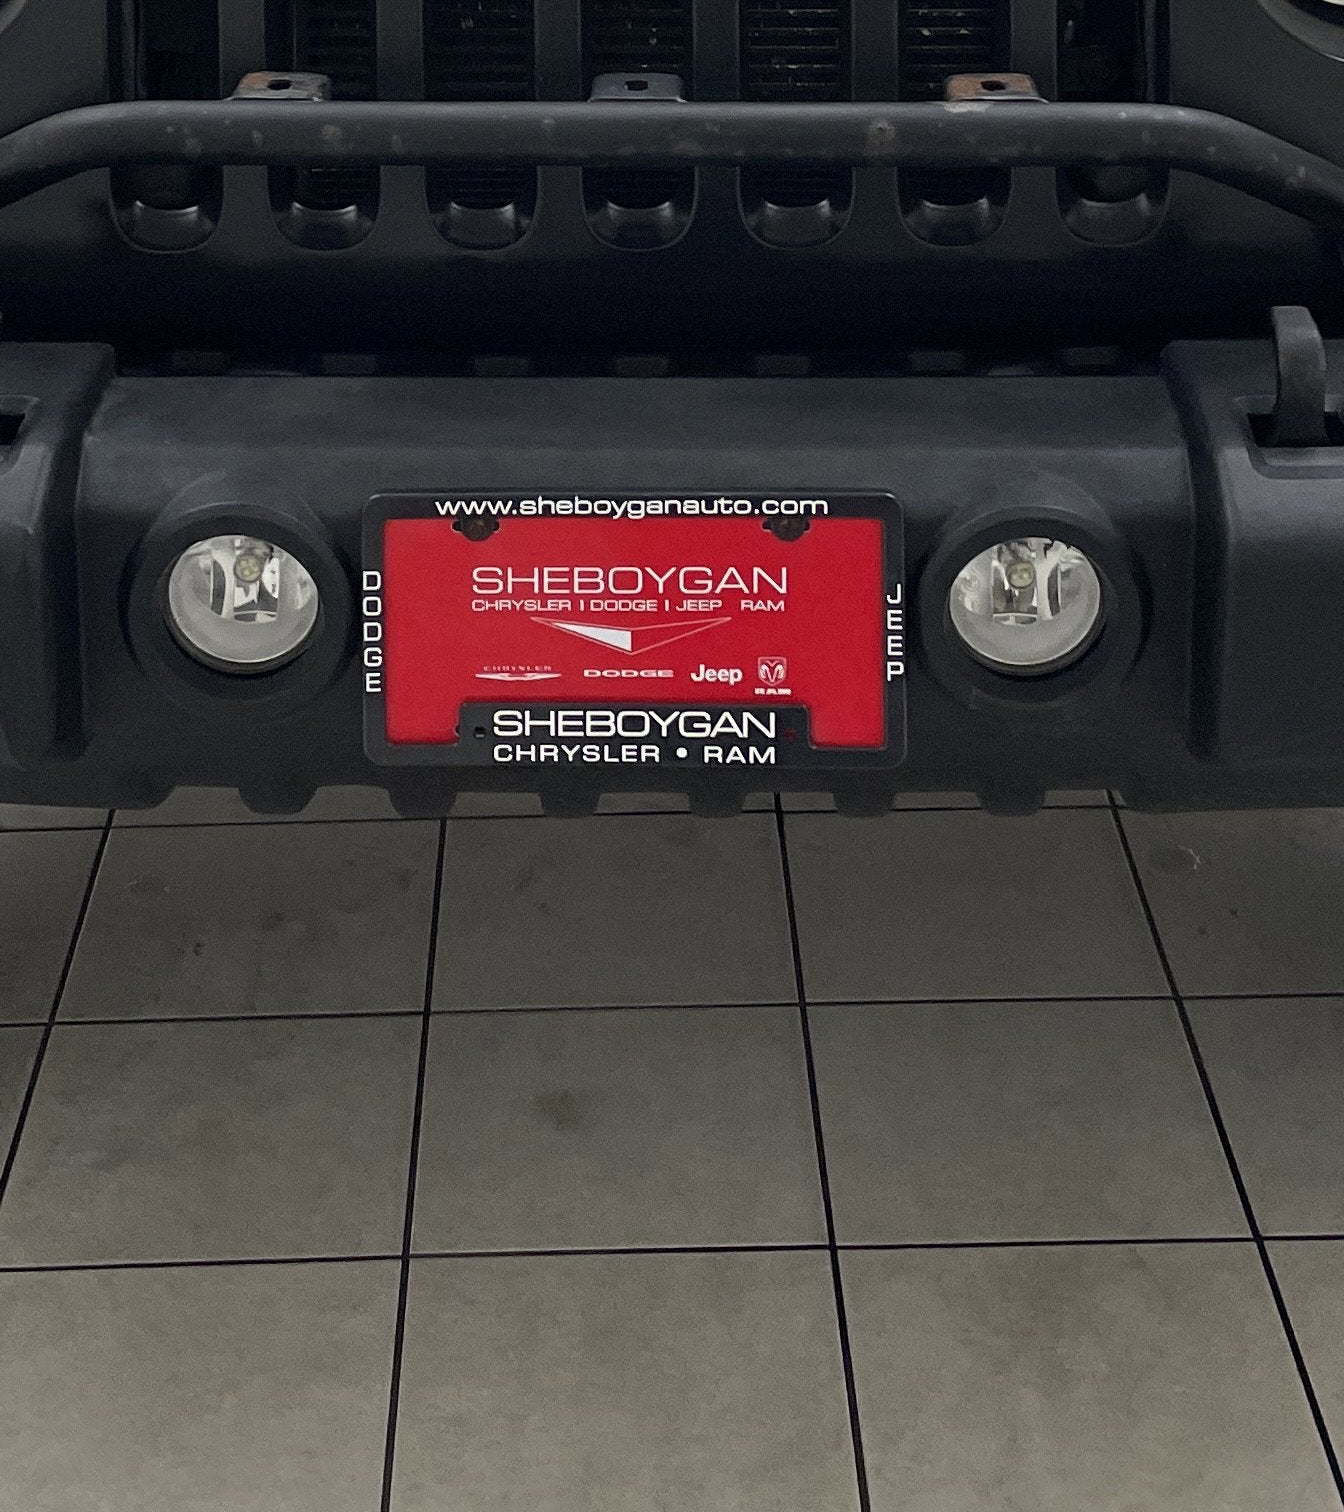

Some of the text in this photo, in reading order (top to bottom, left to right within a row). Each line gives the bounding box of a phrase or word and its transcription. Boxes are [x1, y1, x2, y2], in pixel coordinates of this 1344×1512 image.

[435, 495, 828, 519] www.sheboyganauto.com
[472, 566, 787, 595] SHEBOYGAN
[471, 599, 785, 612] CHRYSLER DODGE JEEP RAM
[362, 570, 383, 693] DODGE
[886, 583, 905, 682] JEEP
[583, 669, 674, 678] DODGE
[690, 663, 743, 686] Jeep
[493, 709, 776, 739] SHEBOYGAN
[493, 744, 776, 765] CHRYSLER RAM
